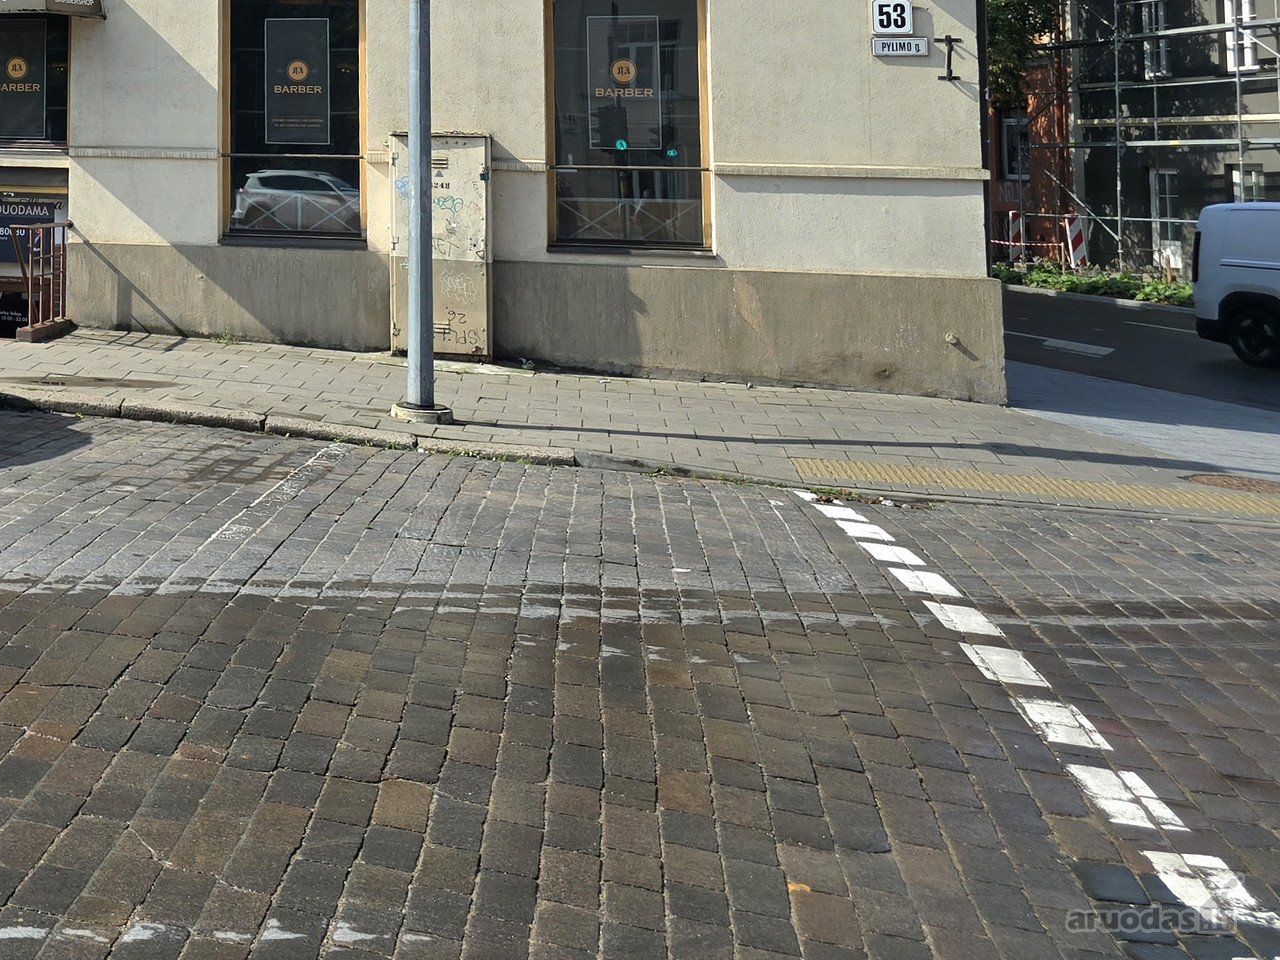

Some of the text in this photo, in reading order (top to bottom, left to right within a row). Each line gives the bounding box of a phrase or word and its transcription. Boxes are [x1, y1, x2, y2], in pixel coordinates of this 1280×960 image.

[878, 3, 906, 29] 53
[881, 42, 912, 52] PYLIMO
[274, 85, 322, 94] BARBER
[595, 88, 654, 97] BARBER
